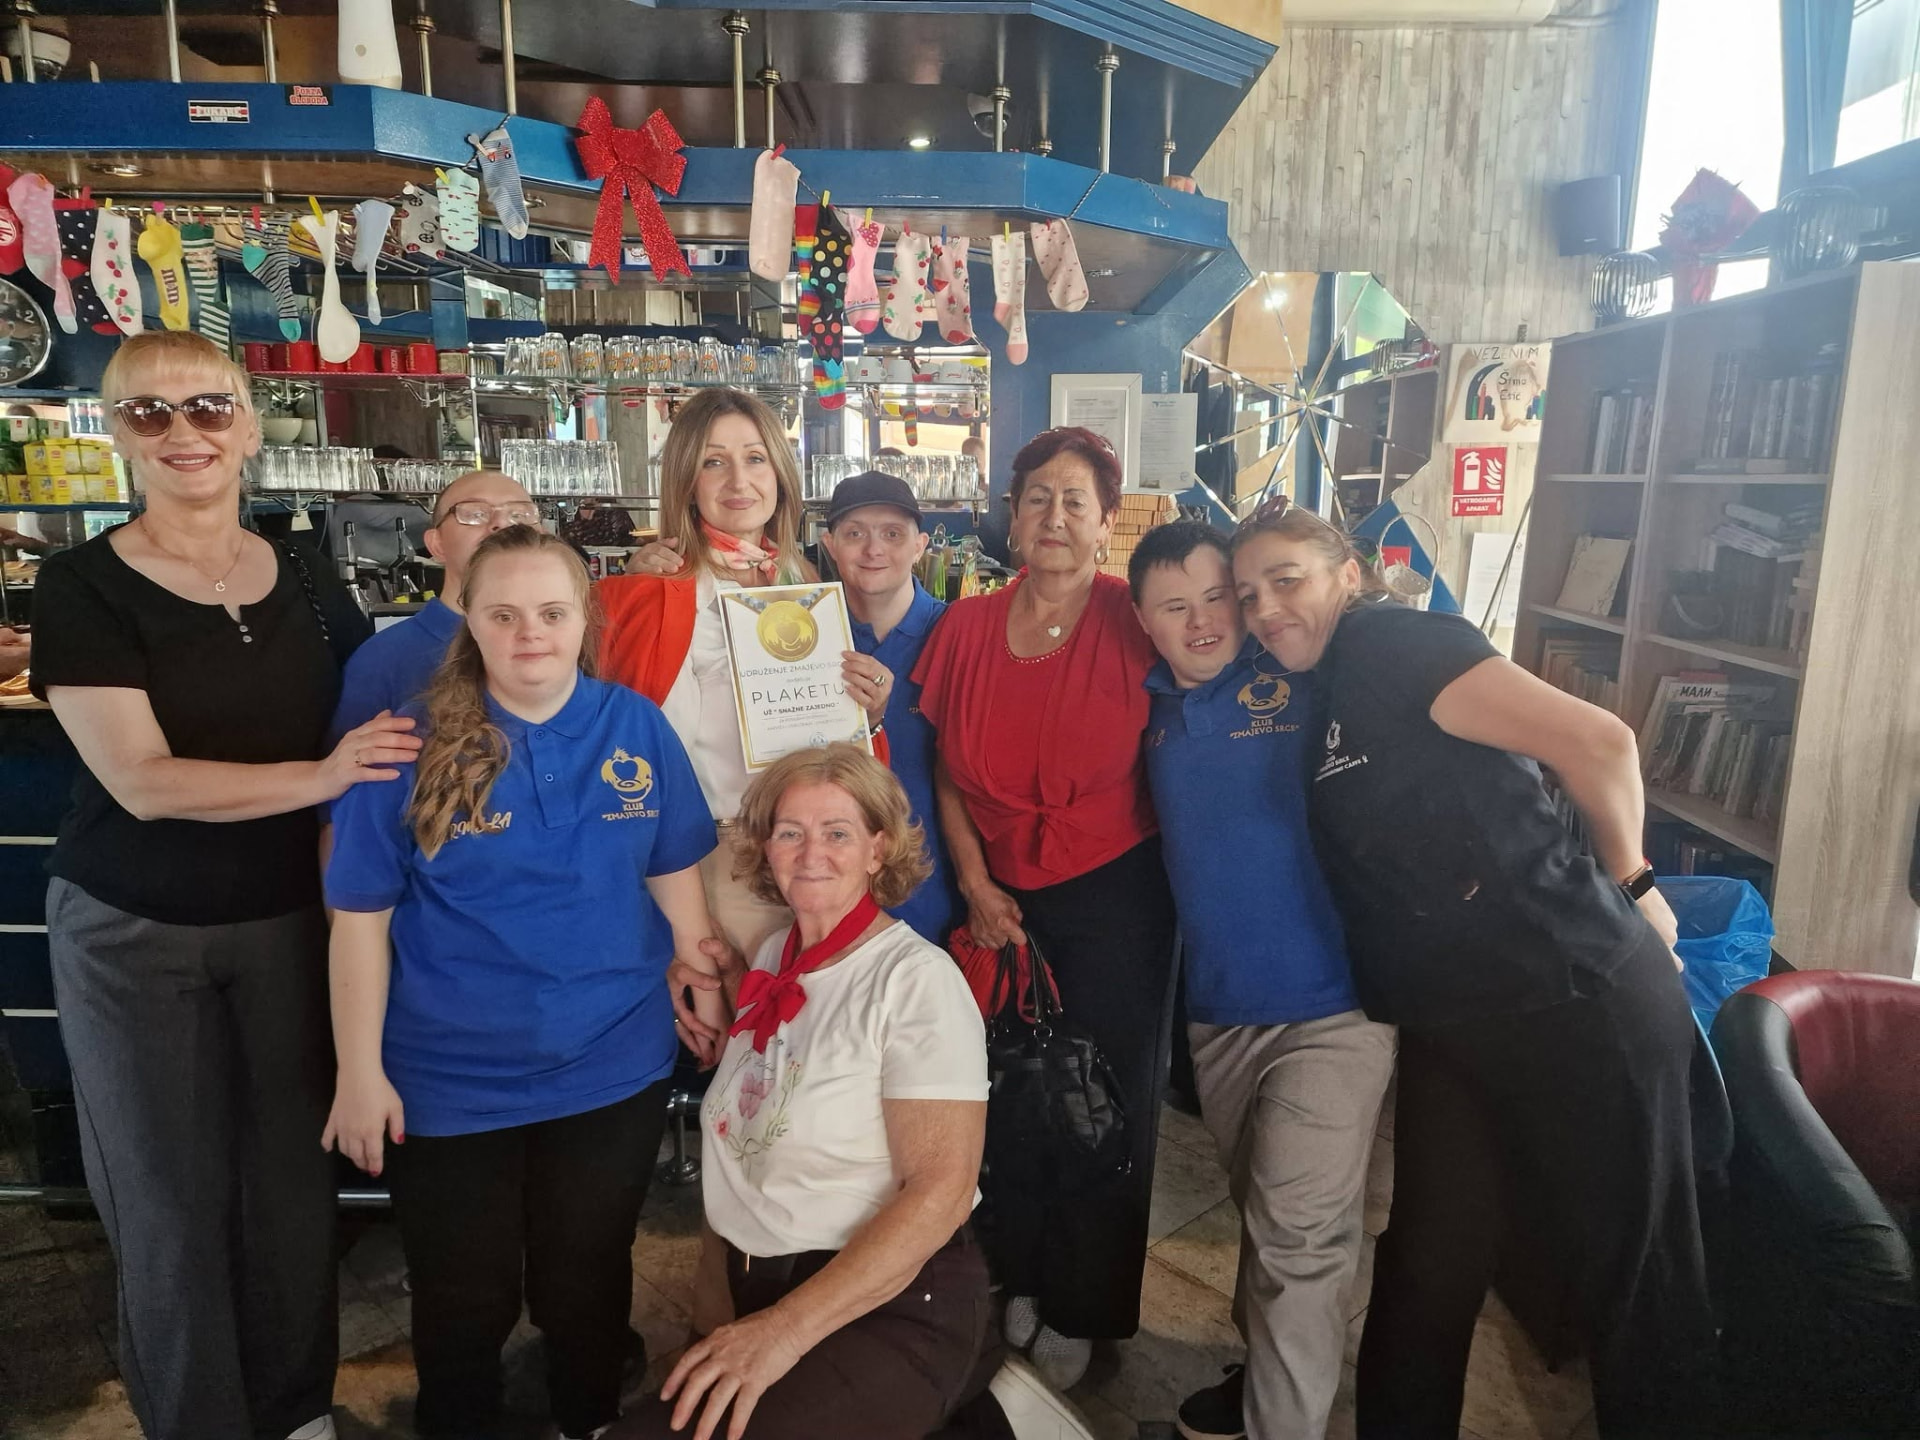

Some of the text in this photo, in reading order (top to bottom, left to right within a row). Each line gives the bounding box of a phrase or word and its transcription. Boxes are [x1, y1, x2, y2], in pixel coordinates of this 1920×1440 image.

[1473, 346, 1523, 360] VEZENI
[789, 661, 826, 672] ZMAJEVO
[751, 682, 845, 705] PLAKETU
[1680, 686, 1713, 698] МАЛИ
[805, 702, 836, 711] ZAJEDNO
[1251, 719, 1273, 728] KLUB
[622, 802, 645, 811] KLUB
